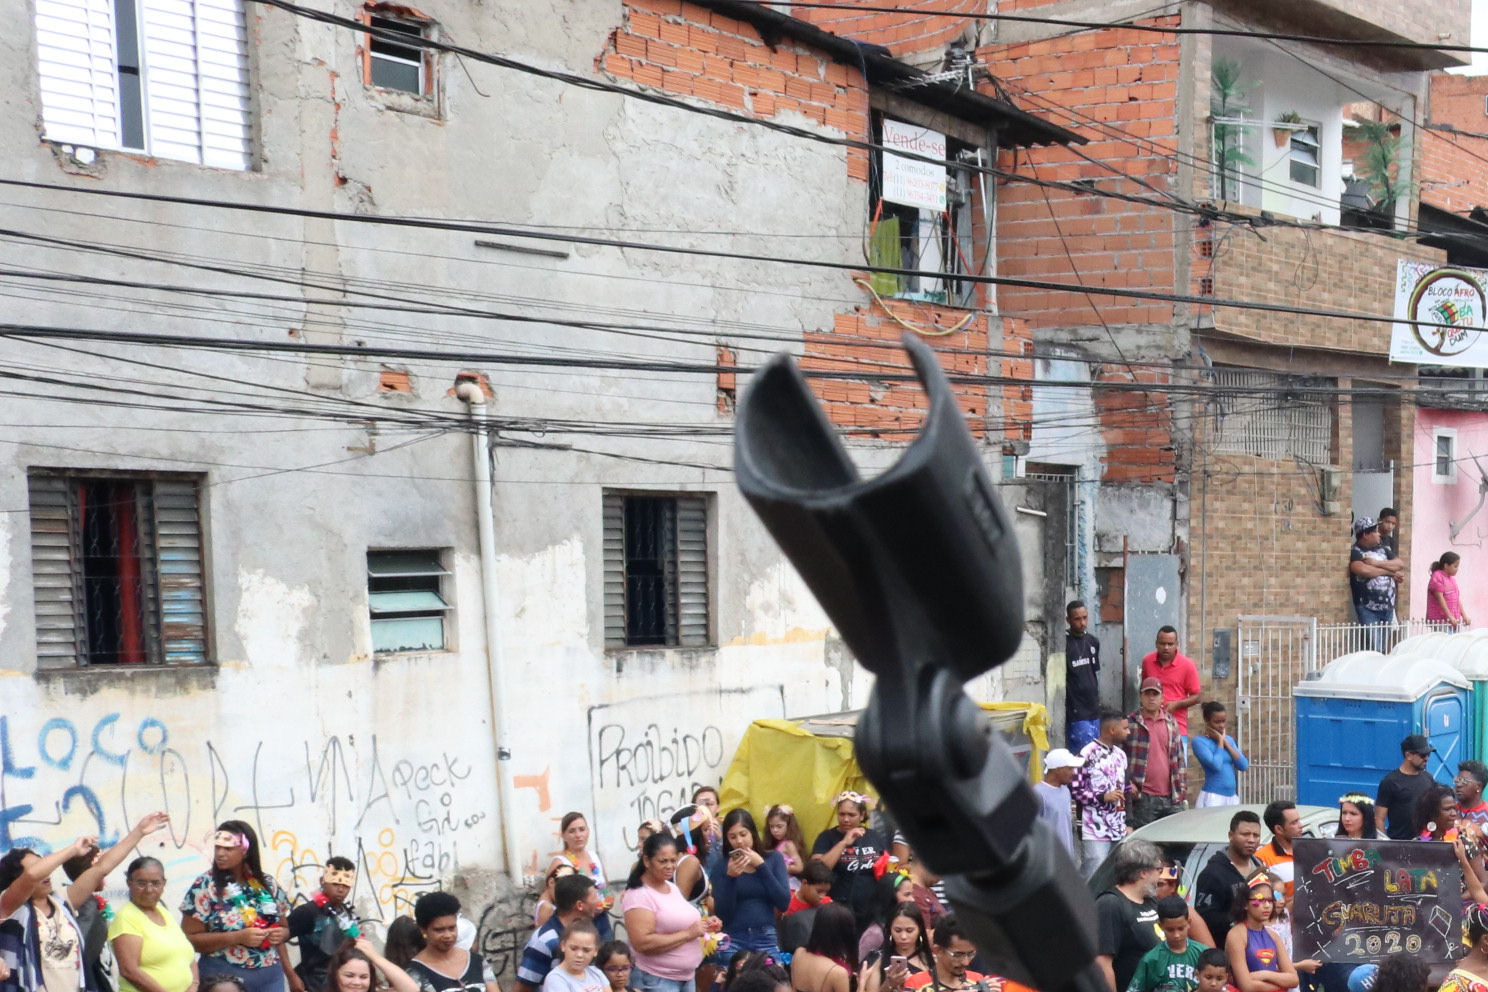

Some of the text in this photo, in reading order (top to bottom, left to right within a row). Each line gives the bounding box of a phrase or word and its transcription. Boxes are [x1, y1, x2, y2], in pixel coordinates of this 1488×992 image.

[883, 125, 946, 156] Vende-se
[1428, 286, 1453, 297] BLOCO
[1311, 848, 1382, 883] TIMBA
[1345, 931, 1422, 956] 2020
